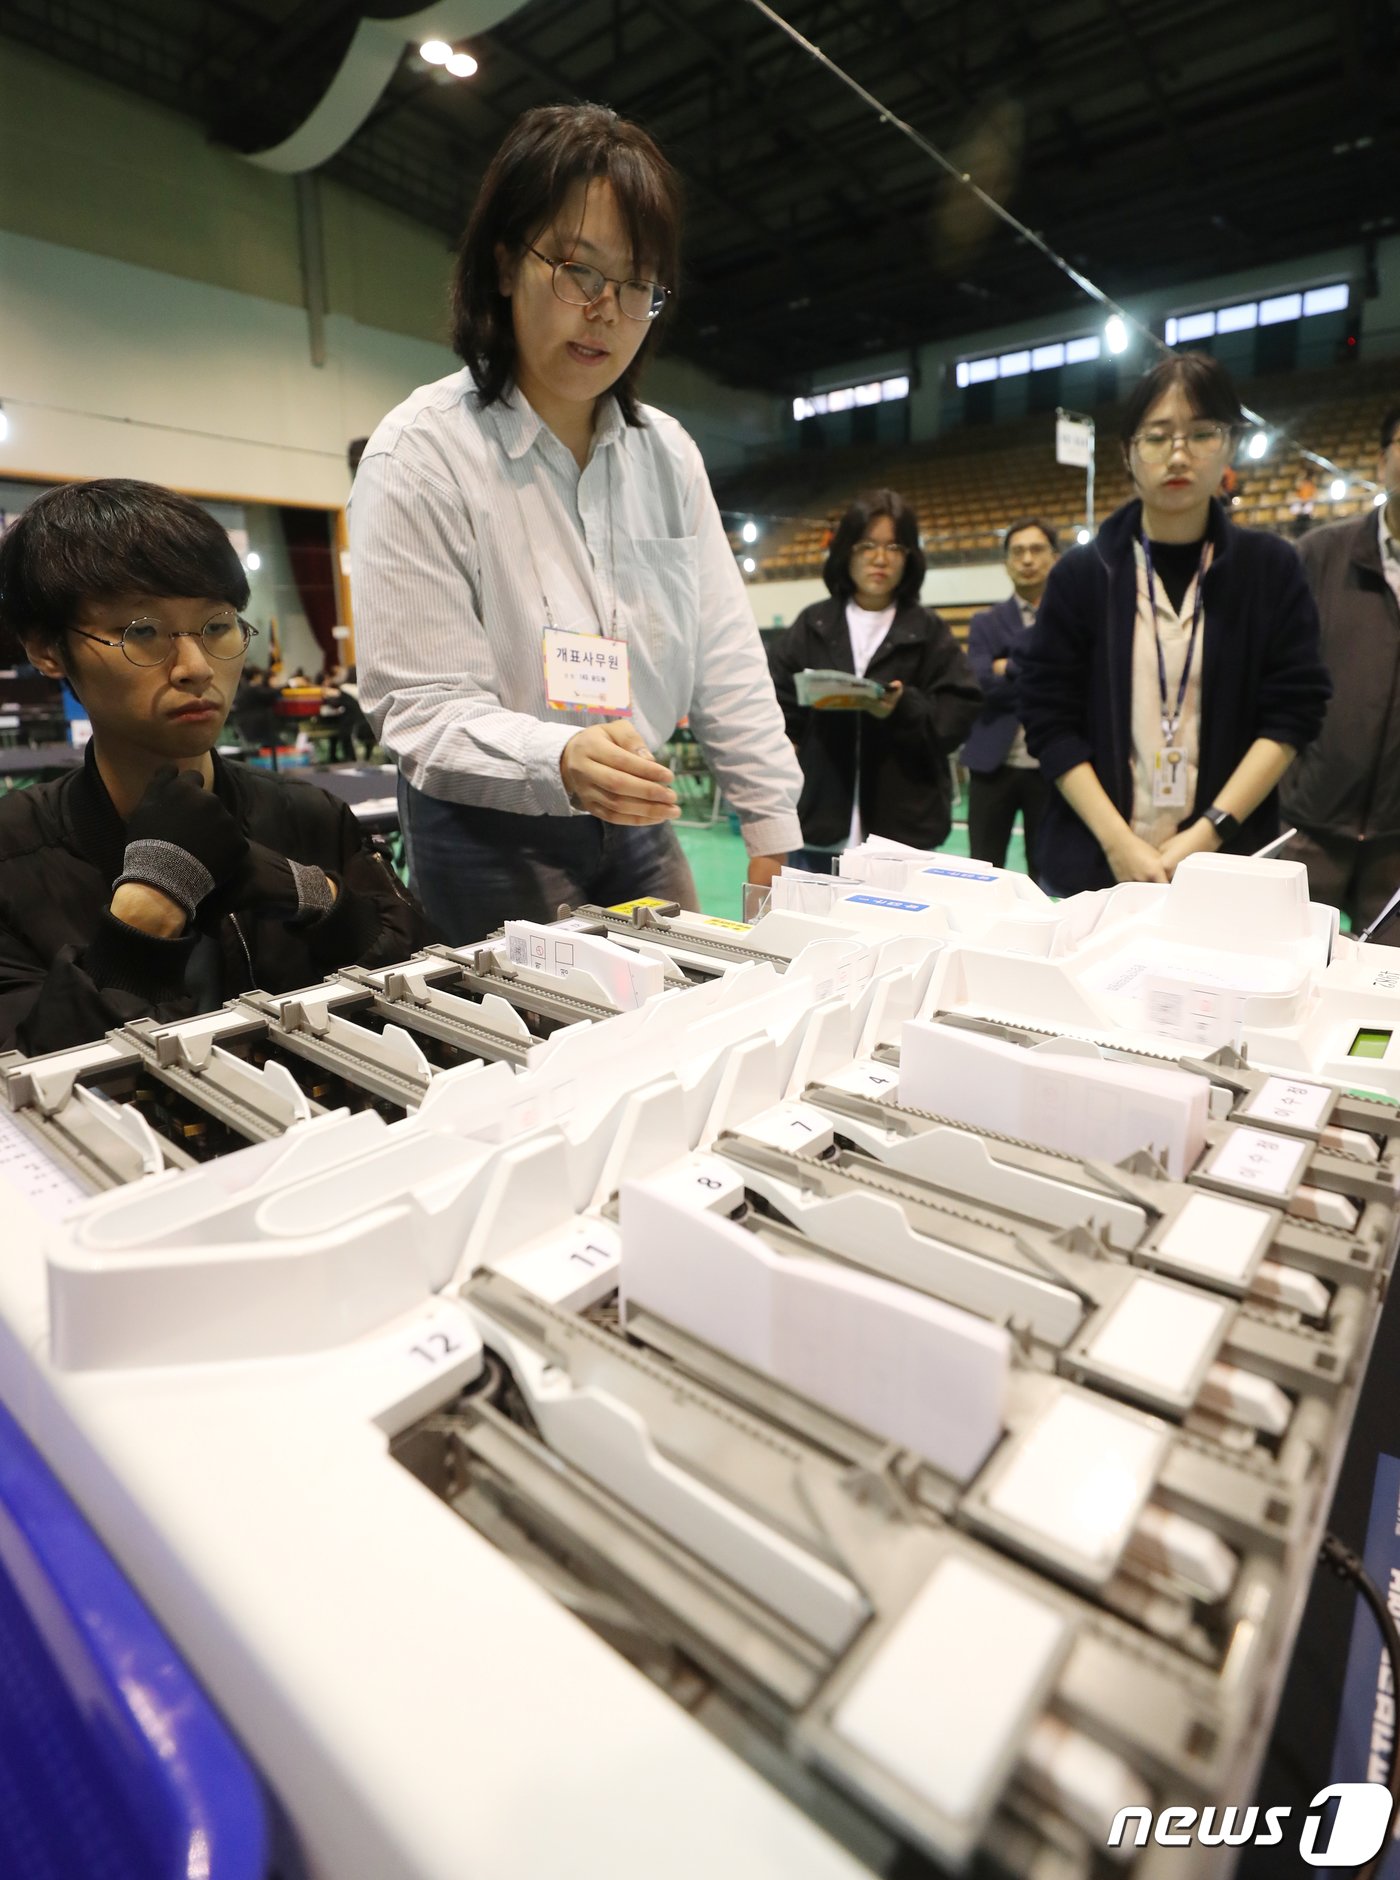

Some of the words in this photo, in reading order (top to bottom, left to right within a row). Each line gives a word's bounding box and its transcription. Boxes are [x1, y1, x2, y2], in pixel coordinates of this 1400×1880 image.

[556, 647, 619, 670] 개표사무원
[868, 1075, 890, 1085] 4
[790, 1120, 813, 1132] 7
[697, 1176, 722, 1190] 8
[570, 1244, 611, 1267] 11
[409, 1333, 461, 1364] 12
